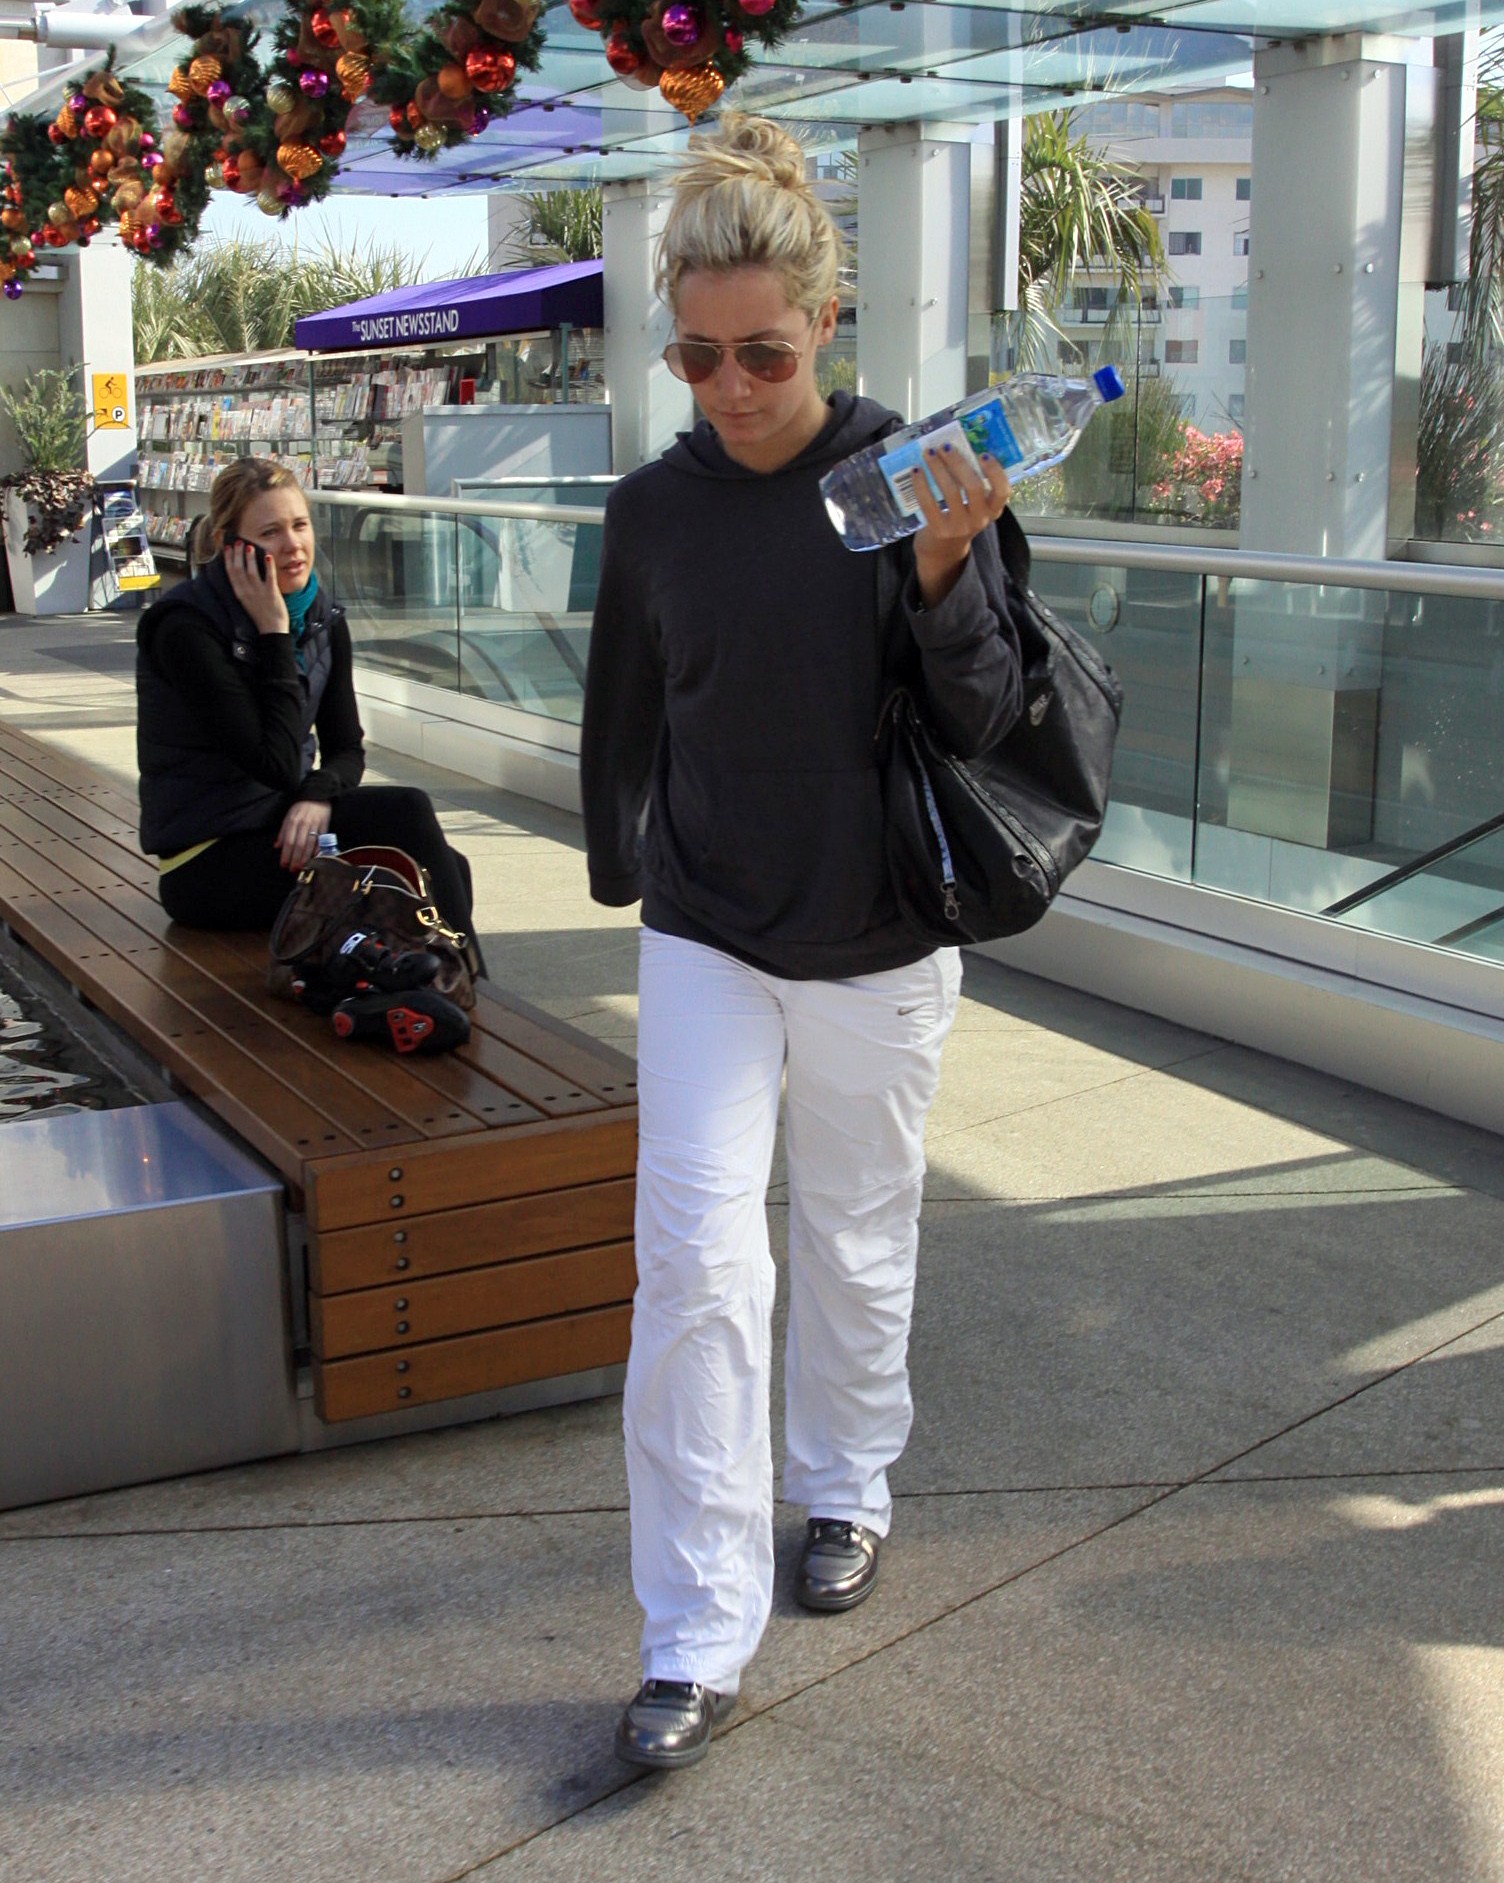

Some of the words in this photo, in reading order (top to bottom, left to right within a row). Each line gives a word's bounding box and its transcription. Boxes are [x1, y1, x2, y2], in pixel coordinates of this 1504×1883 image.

[360, 316, 395, 341] SUNSET
[395, 309, 459, 338] NEWSSTAND
[115, 410, 123, 419] P
